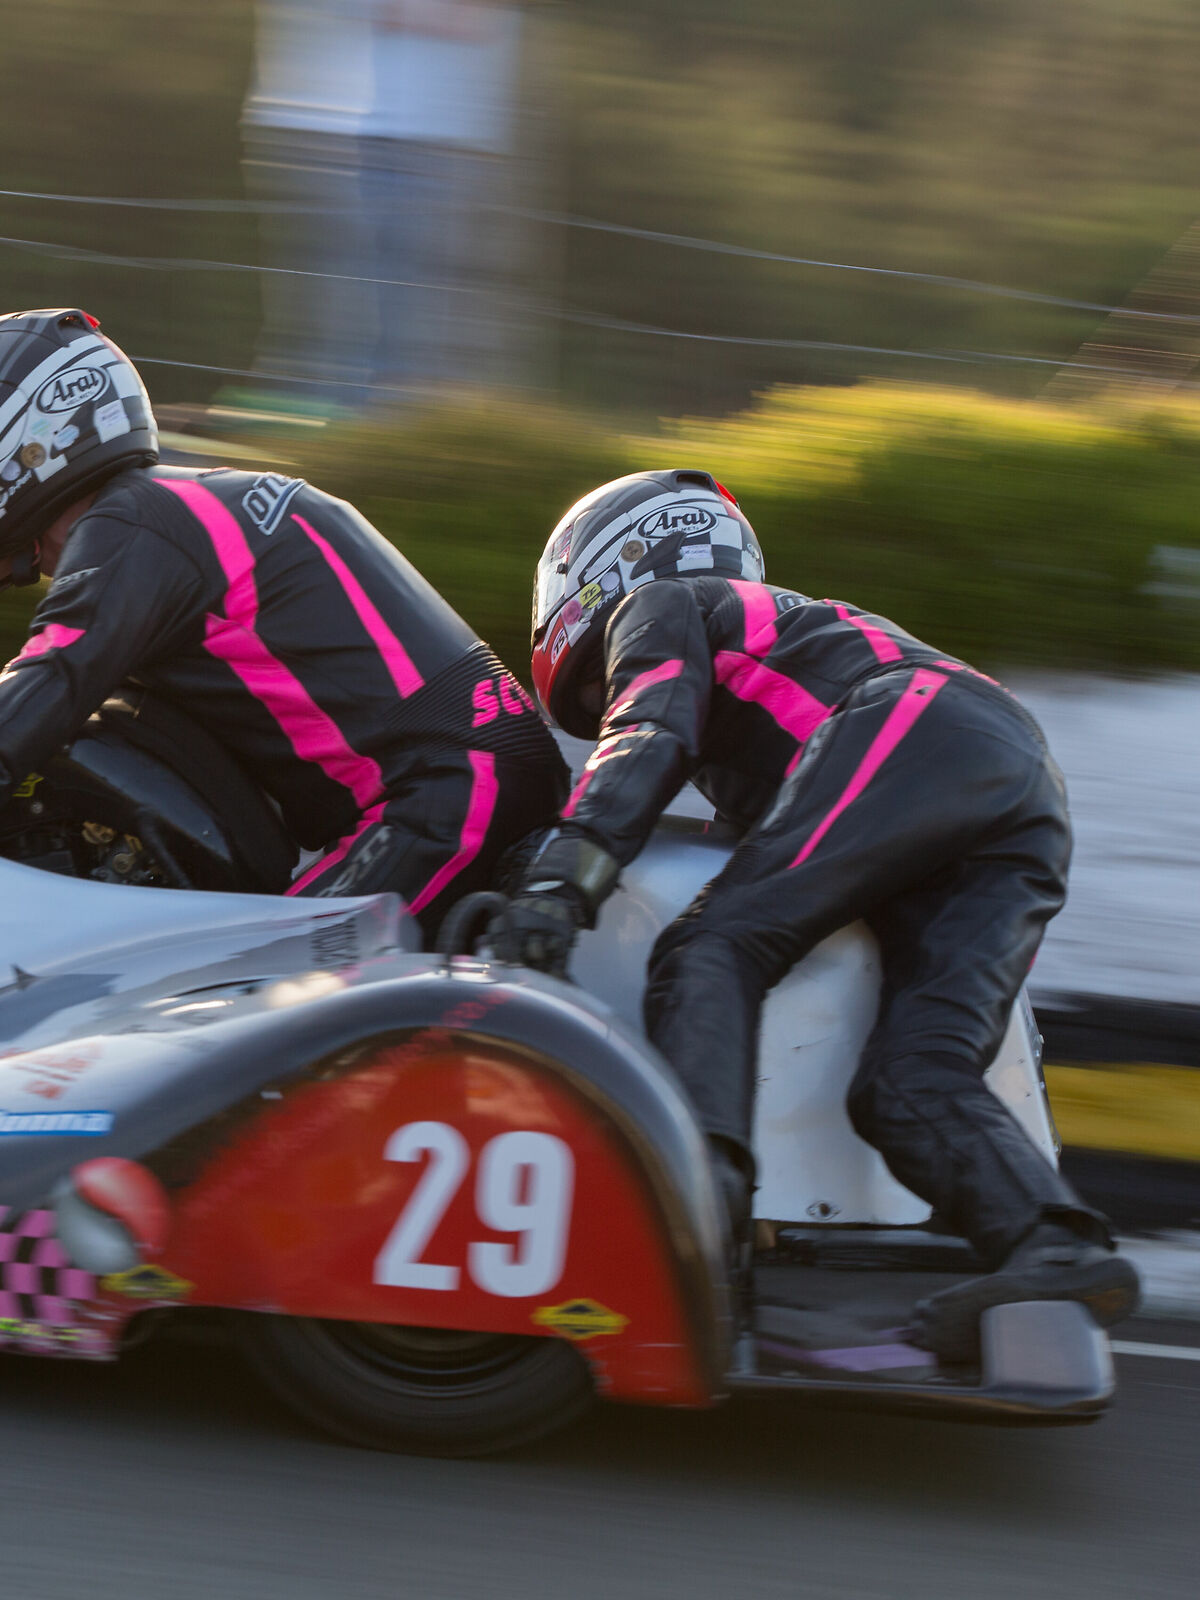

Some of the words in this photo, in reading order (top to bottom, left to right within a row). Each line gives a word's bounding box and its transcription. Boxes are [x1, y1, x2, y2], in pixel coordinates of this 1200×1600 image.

[42, 367, 100, 411] Arai
[644, 508, 709, 537] Arai
[372, 1120, 577, 1298] 29
